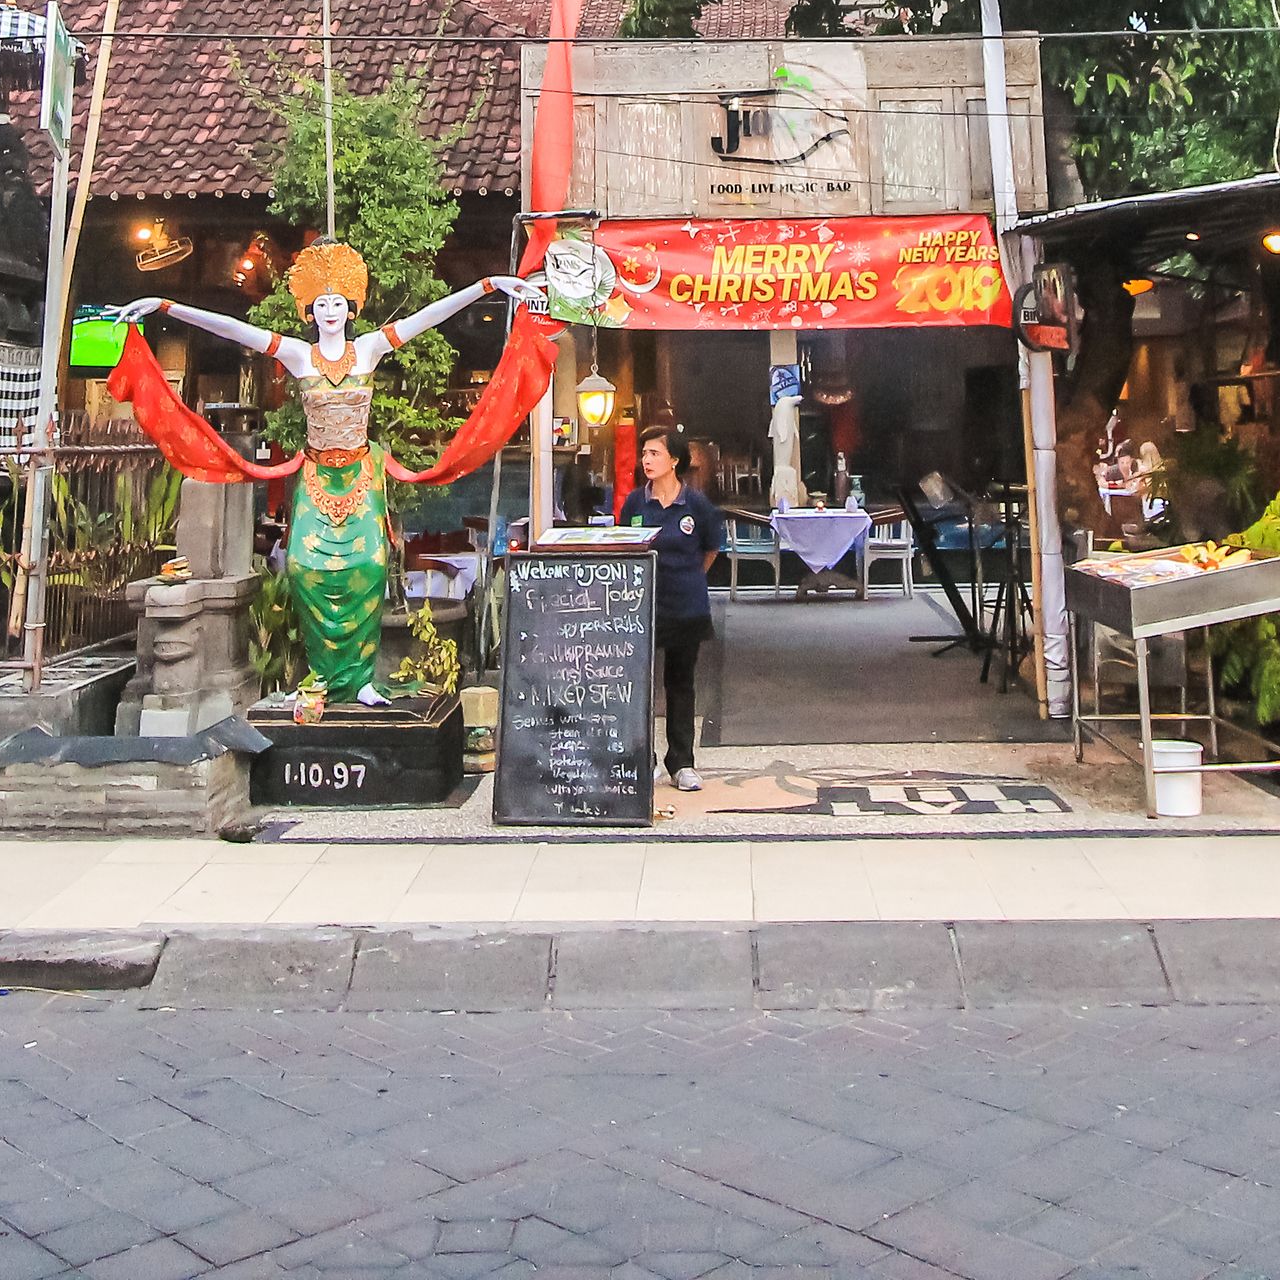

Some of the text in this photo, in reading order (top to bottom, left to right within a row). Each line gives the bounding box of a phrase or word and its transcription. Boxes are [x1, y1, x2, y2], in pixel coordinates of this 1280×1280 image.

[826, 182, 852, 193] BAR
[918, 231, 981, 246] HAPPY
[712, 244, 835, 274] MERRY
[898, 245, 1000, 264] NEW YEARS
[670, 271, 879, 303] CHRISTMAS
[893, 265, 1002, 313] 2019
[518, 561, 628, 587] Welcome To JONI
[601, 581, 644, 616] Today
[584, 663, 625, 679] Sauce
[589, 681, 633, 709] STEW
